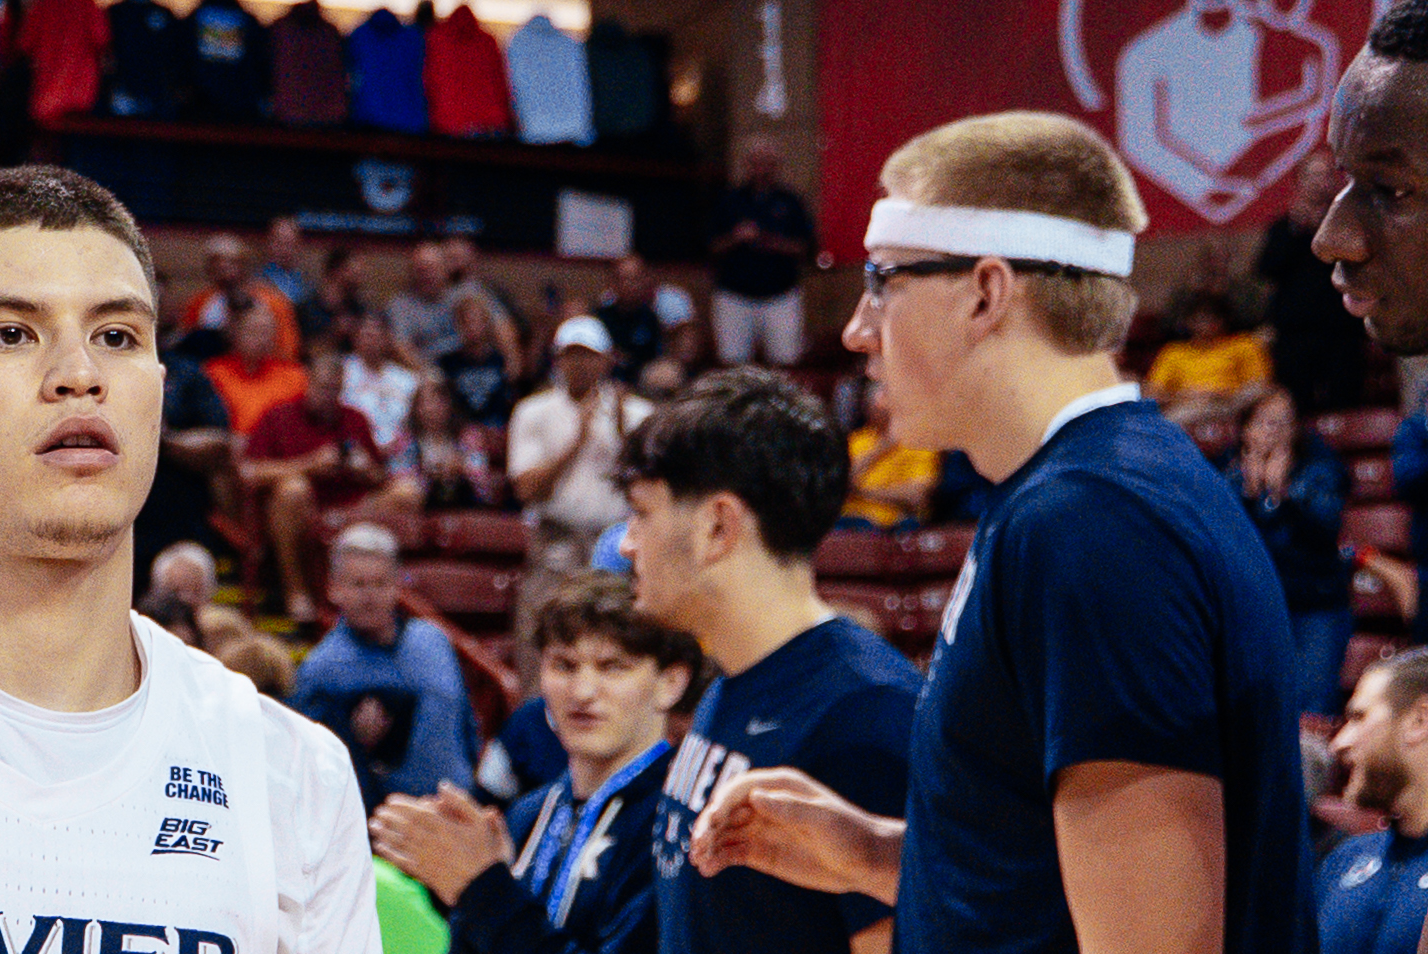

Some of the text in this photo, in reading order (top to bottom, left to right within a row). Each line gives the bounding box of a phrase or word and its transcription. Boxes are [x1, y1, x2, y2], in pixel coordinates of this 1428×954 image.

[169, 766, 225, 791] BE THE
[164, 782, 230, 809] CHANGE
[159, 817, 210, 836] BIG
[154, 833, 224, 853] EAST
